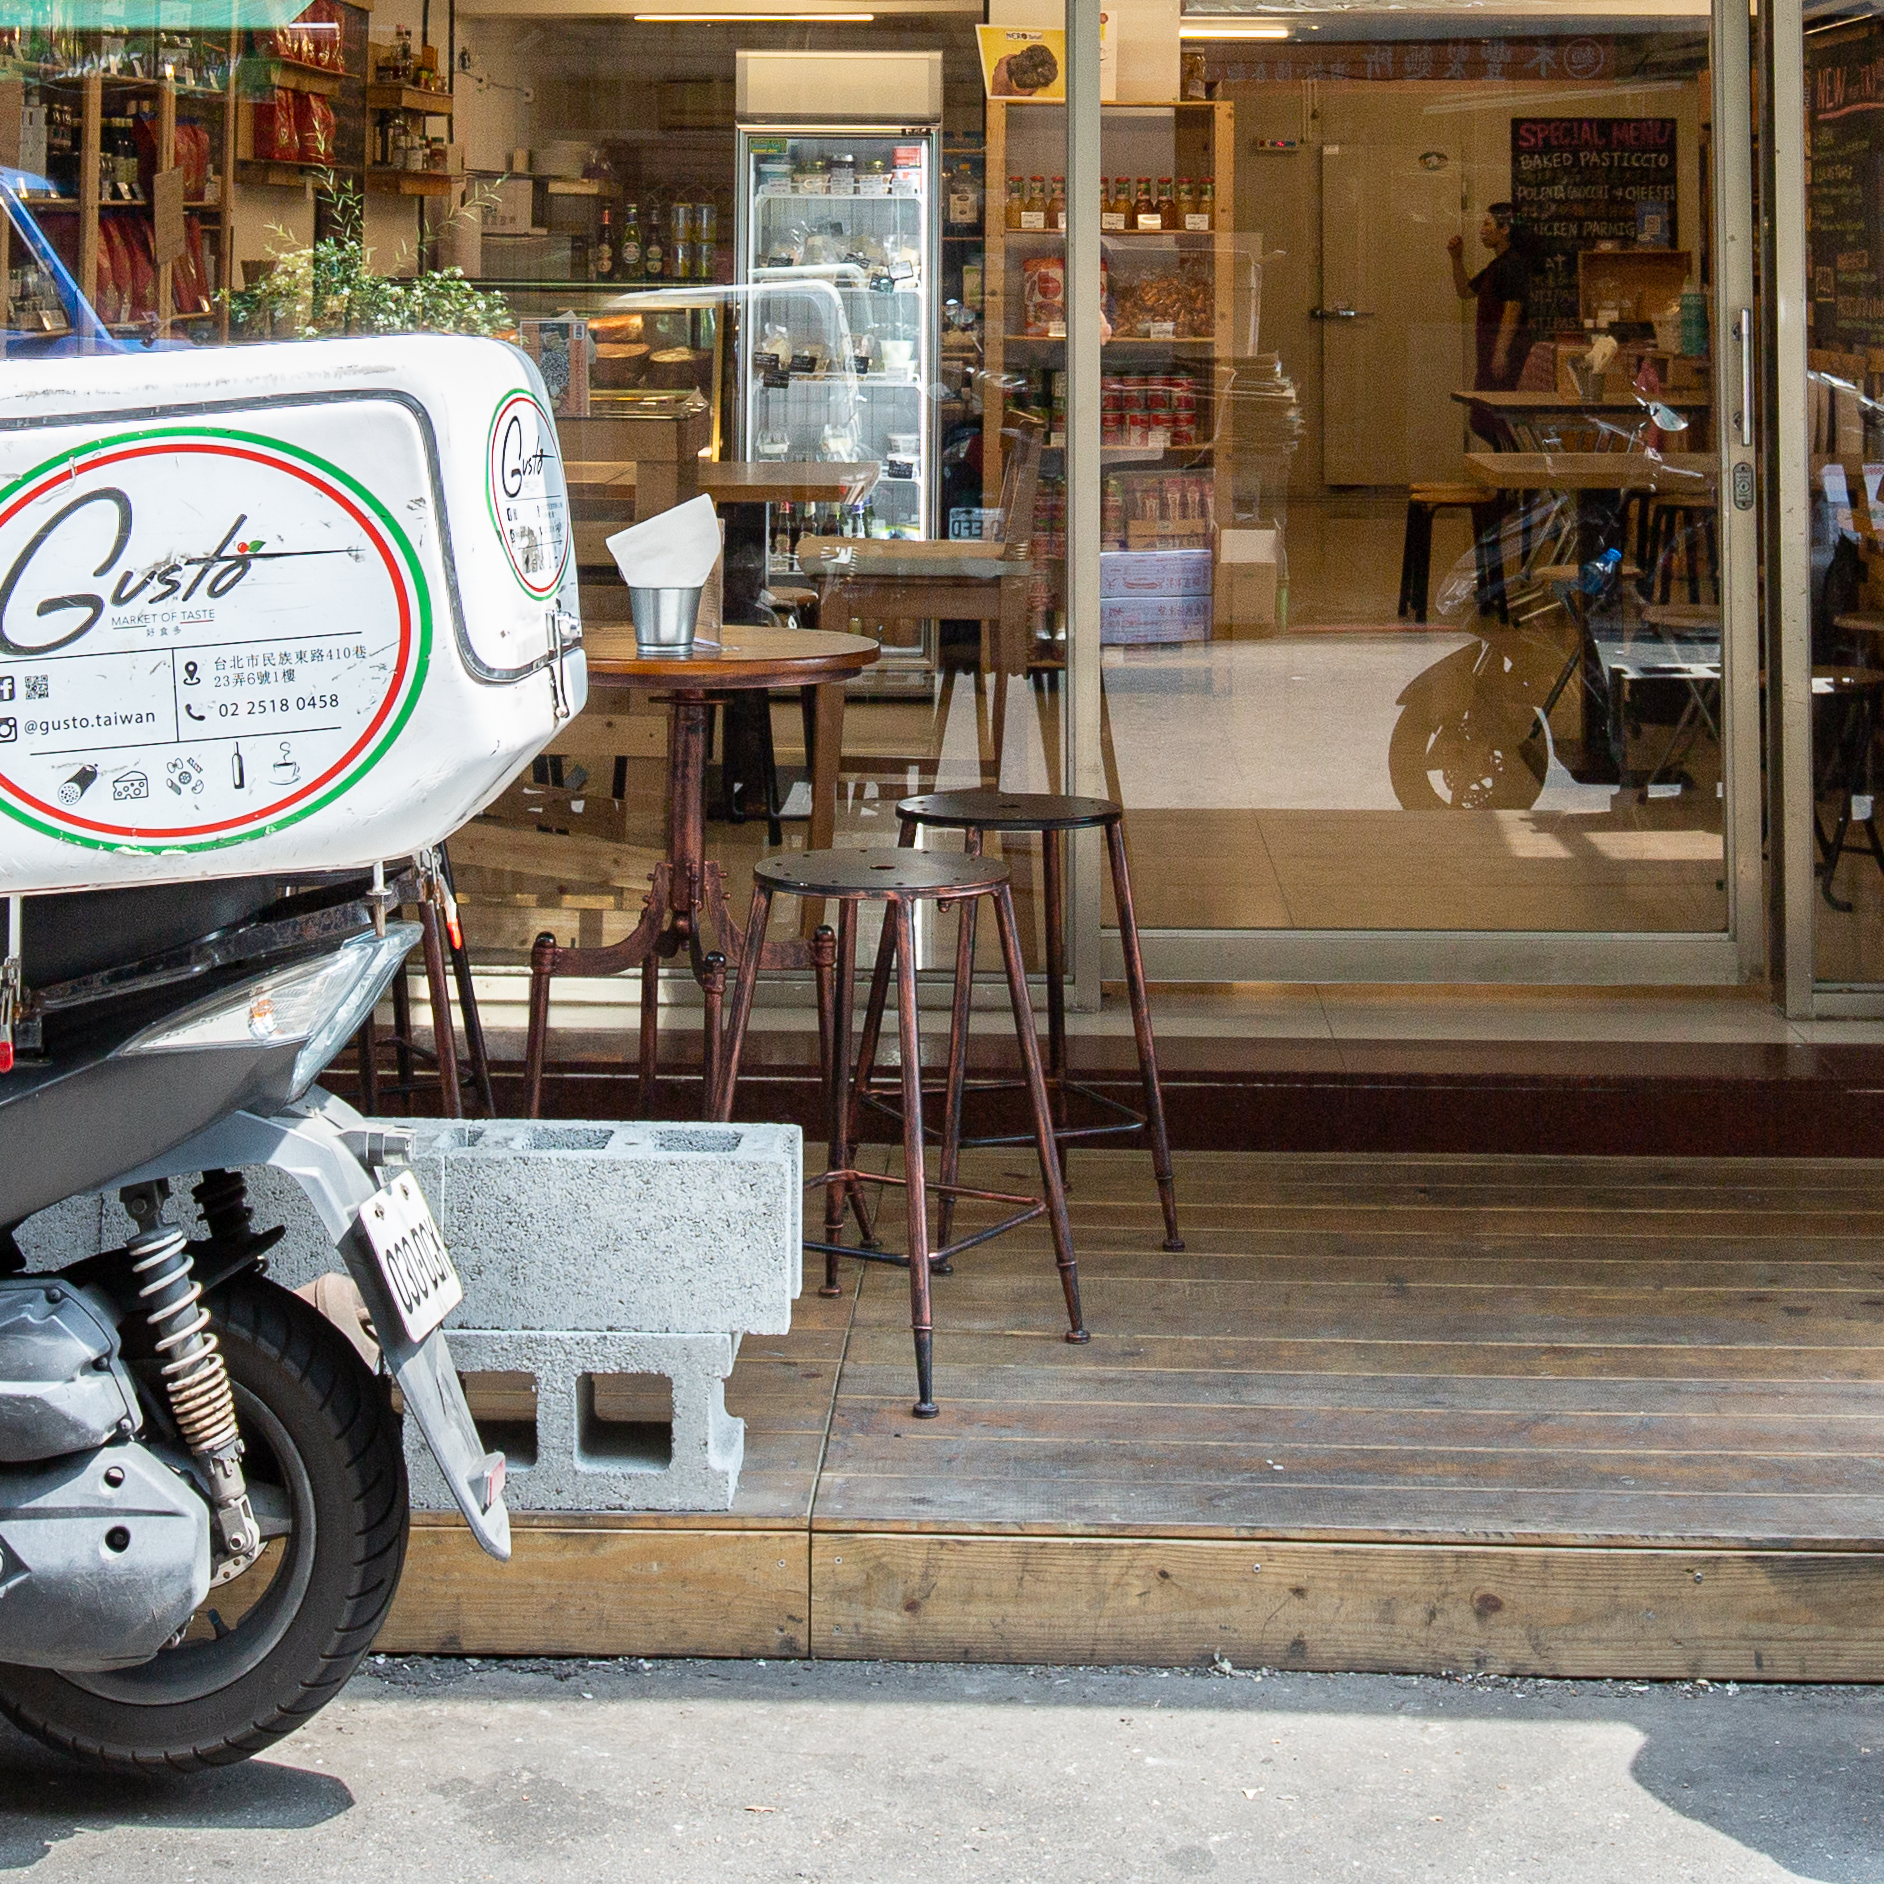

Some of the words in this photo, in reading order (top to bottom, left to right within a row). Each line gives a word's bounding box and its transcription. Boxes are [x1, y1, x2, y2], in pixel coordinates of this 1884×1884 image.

[1518, 123, 1605, 149] SPECIAL
[1612, 121, 1670, 148] MENU
[1520, 153, 1573, 170] BAKED
[502, 415, 556, 498] Gusto
[111, 614, 155, 627] MARKET
[161, 612, 177, 622] OF
[180, 609, 215, 621] TASTE
[146, 626, 183, 638] 好食多
[213, 645, 368, 672] 台北市民族東路410巷
[214, 668, 296, 689] 23弄6號1樓
[218, 702, 240, 718] 02
[247, 697, 290, 716] 2518
[296, 694, 340, 712] 0458
[24, 709, 156, 736] @gusto.taiwan
